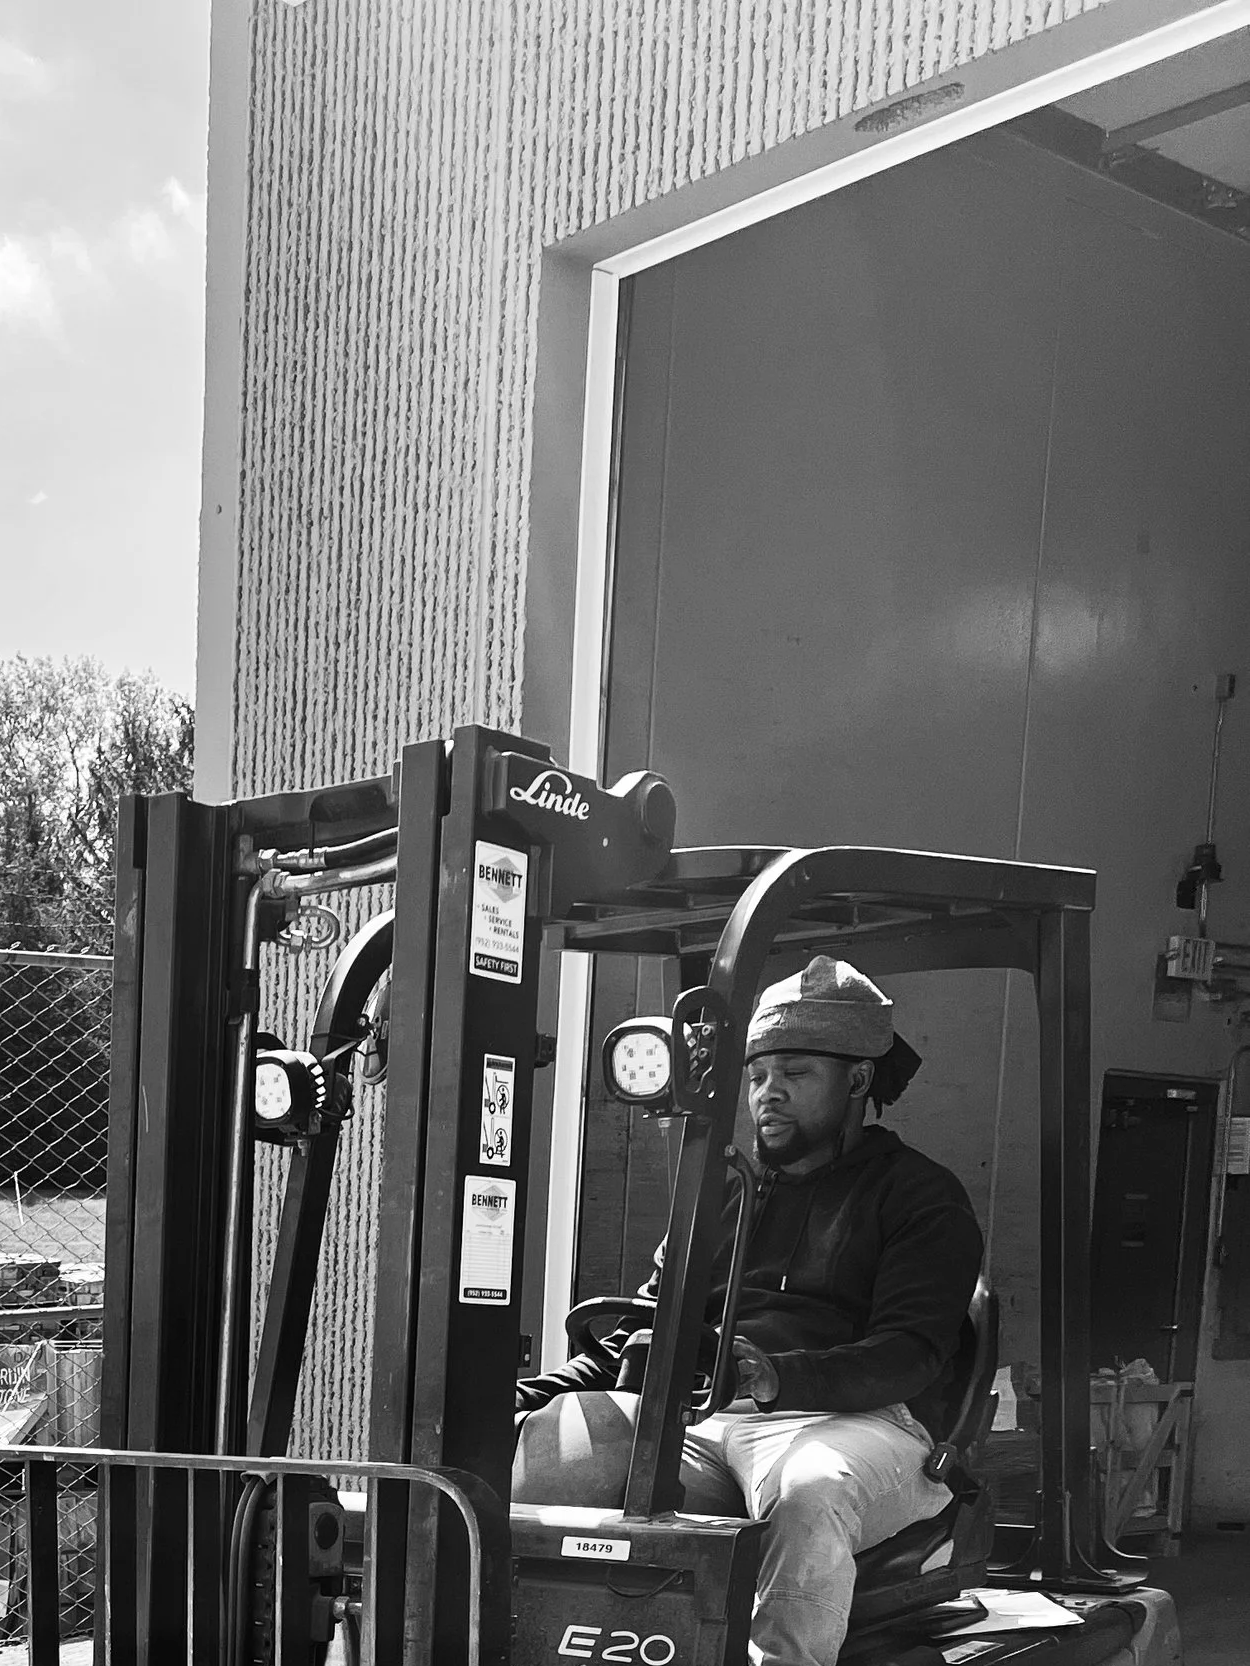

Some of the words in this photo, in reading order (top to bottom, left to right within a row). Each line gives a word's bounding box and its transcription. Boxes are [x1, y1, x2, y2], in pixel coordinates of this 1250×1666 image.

[510, 770, 589, 820] Linde
[479, 864, 523, 888] BENNETT
[481, 904, 500, 915] SALES
[488, 915, 512, 928] SERVICE
[493, 926, 519, 939] RENTALS
[475, 955, 500, 971] SAFETY
[500, 961, 518, 975] FIRST
[471, 1193, 508, 1208] BENNETT
[576, 1542, 613, 1554] 18479
